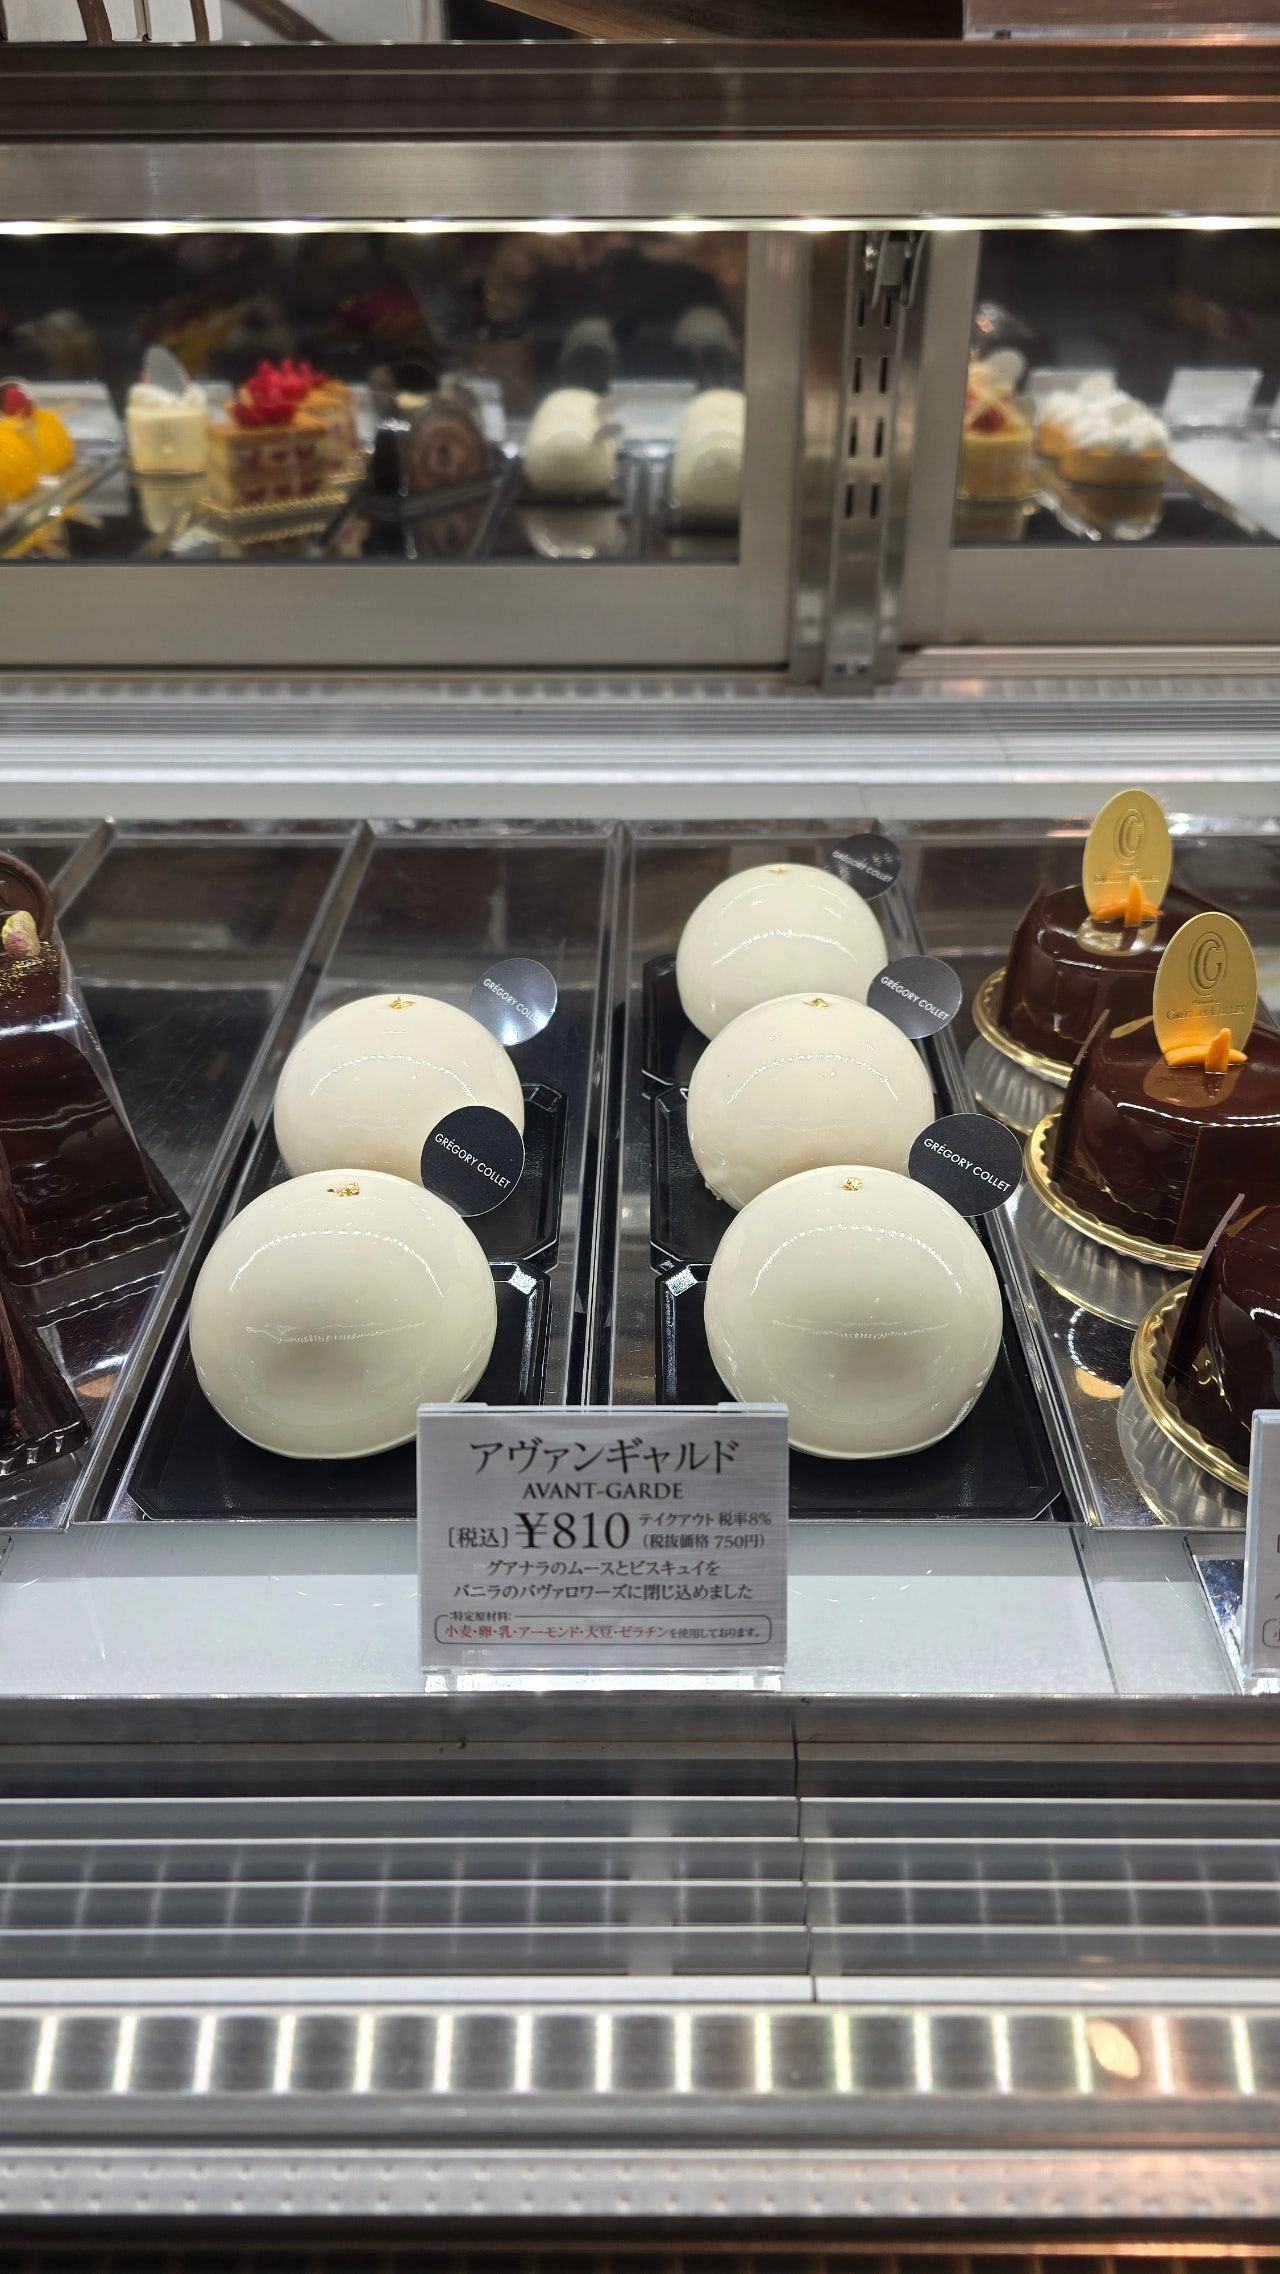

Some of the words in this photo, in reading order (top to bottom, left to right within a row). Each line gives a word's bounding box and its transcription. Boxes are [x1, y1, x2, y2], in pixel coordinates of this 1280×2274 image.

[865, 866, 893, 883] COLLET
[483, 978, 518, 1005] GRÉGORY
[880, 976, 920, 1003] GRÉGORY
[918, 999, 950, 1021] COLLET
[435, 1133, 478, 1166] GRÉGORY
[477, 1162, 511, 1189] COLLET
[923, 1138, 973, 1170] GRÉGORY
[972, 1166, 1011, 1192] COLLET
[470, 1436, 738, 1475] アヴァンギャルド
[522, 1482, 684, 1500] AVANT-GARDE
[514, 1511, 630, 1550] ¥810
[639, 1512, 715, 1527] テイクアウト
[718, 1511, 772, 1526] 税率8%
[487, 1559, 720, 1577] グアナラのムースとビスキュイを
